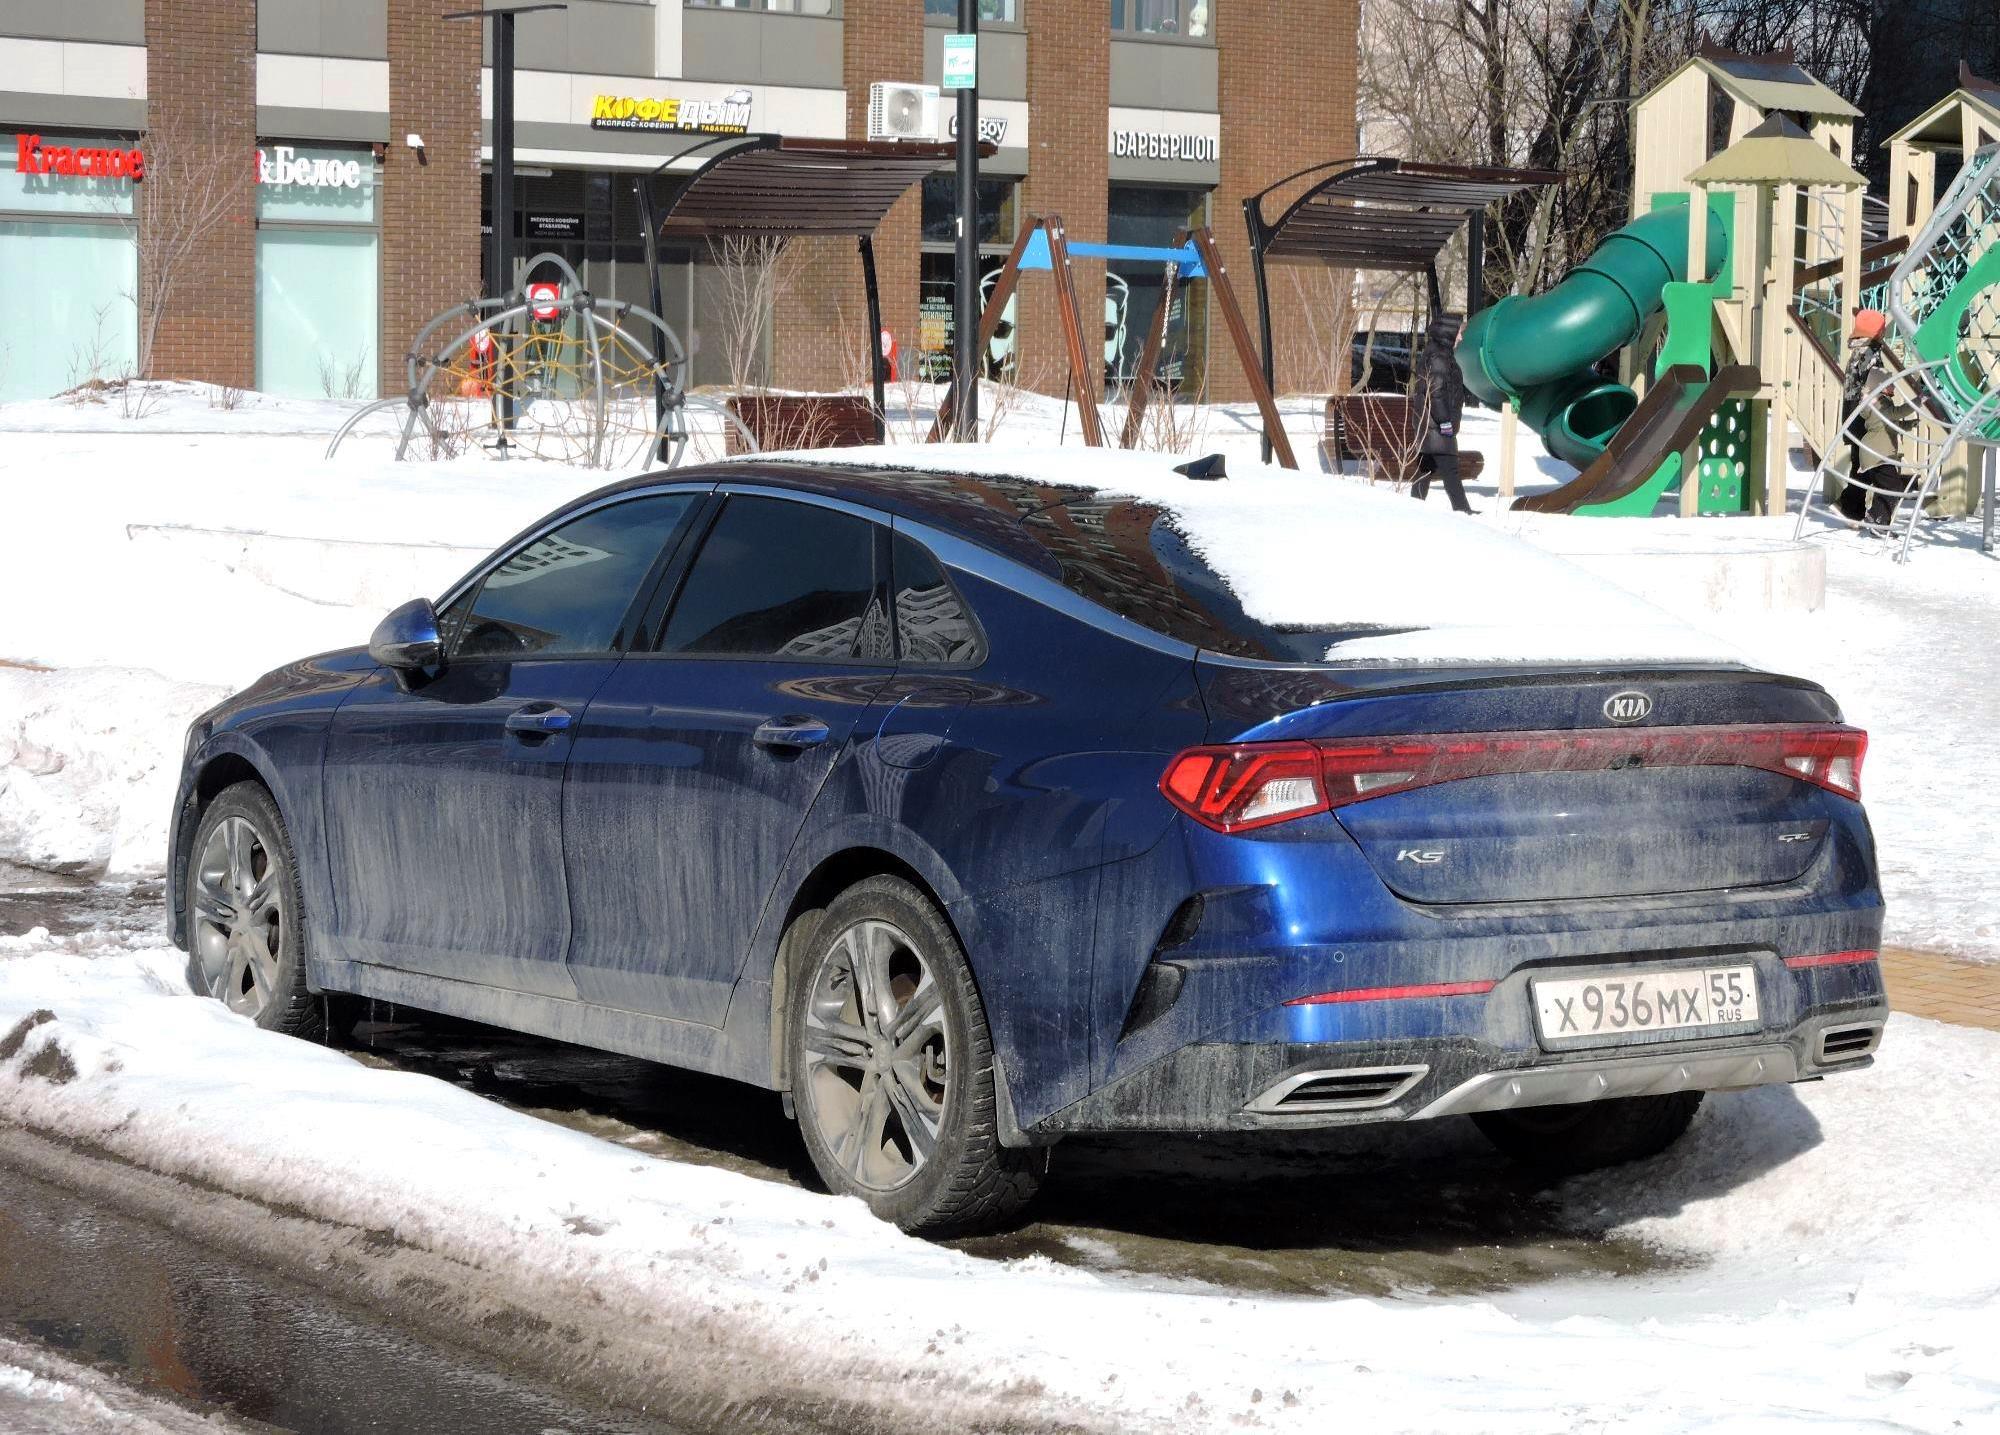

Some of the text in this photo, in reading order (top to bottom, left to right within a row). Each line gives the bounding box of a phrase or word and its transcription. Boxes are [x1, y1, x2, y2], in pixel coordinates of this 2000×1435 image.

[596, 119, 674, 129] ЭКСПРЕСС-КОФЕЙНЯ
[701, 124, 744, 133] ТАБАКЕРКА
[16, 134, 143, 178] Красное
[1114, 129, 1216, 162] БАРБЕРШОП
[956, 217, 963, 238] 1
[1612, 698, 1645, 717] KIA
[1710, 972, 1744, 1007] 55
[1717, 1008, 1742, 1022] RUS
